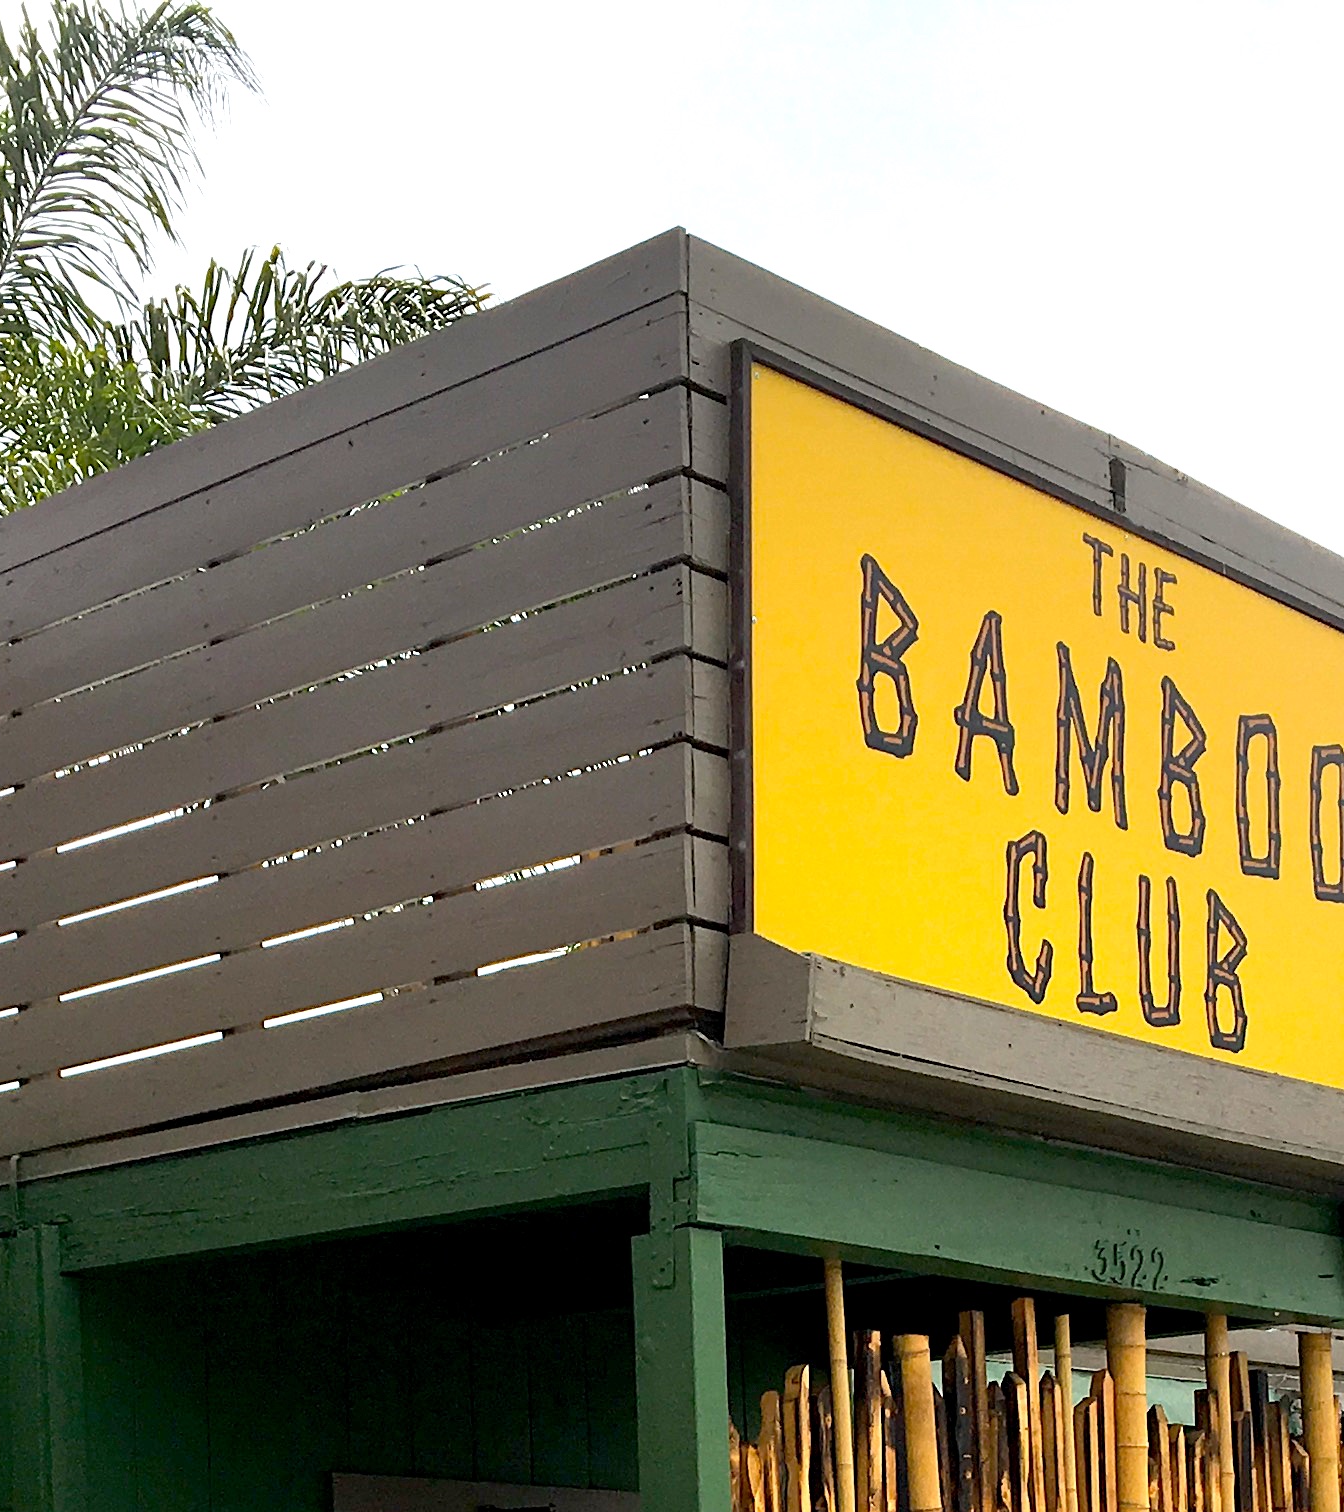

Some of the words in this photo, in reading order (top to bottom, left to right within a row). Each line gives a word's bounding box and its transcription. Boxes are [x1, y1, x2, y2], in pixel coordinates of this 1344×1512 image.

[1083, 532, 1177, 651] THE
[1004, 830, 1248, 1053] CLUB
[1091, 1239, 1169, 1291] 3522
